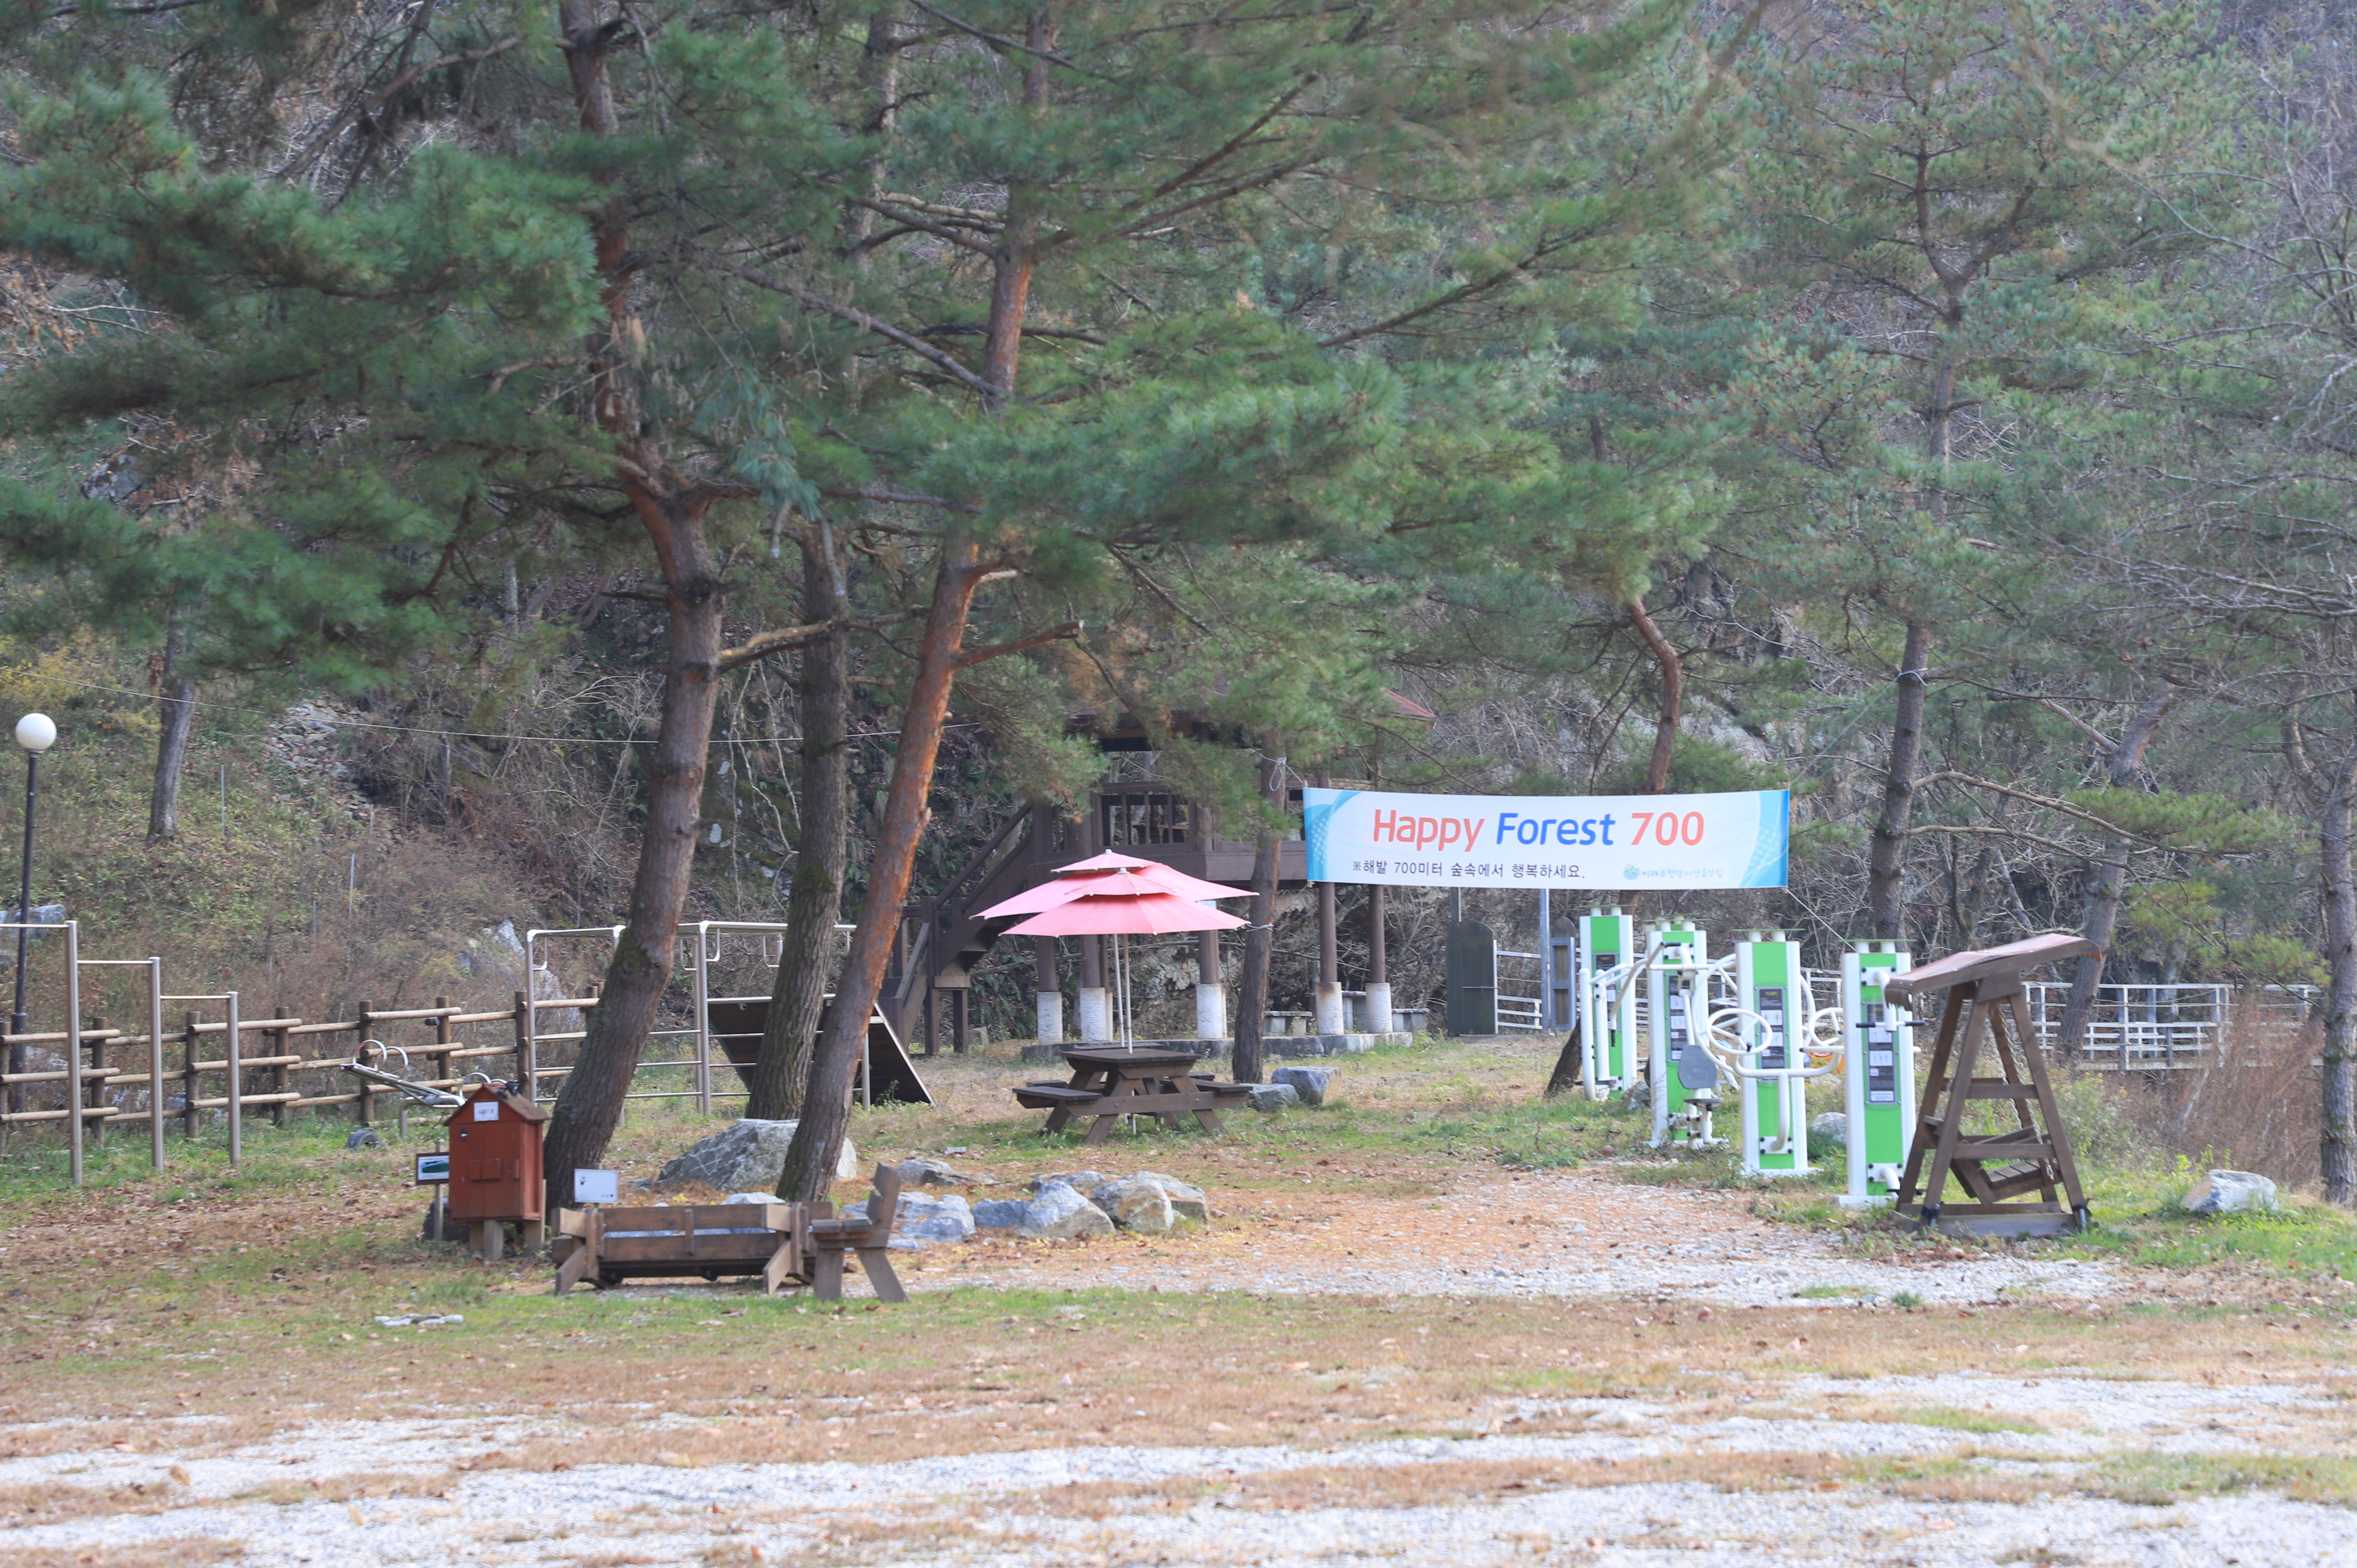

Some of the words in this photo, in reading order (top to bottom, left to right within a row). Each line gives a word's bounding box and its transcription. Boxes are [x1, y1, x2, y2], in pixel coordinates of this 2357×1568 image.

[1373, 809, 1485, 852] Happy
[1496, 812, 1616, 846] Forest
[1630, 811, 1705, 846] 700
[1394, 862, 1443, 876] 700미터
[1450, 862, 1504, 877] 숲속에서
[1512, 863, 1585, 879] 행복하세요.
